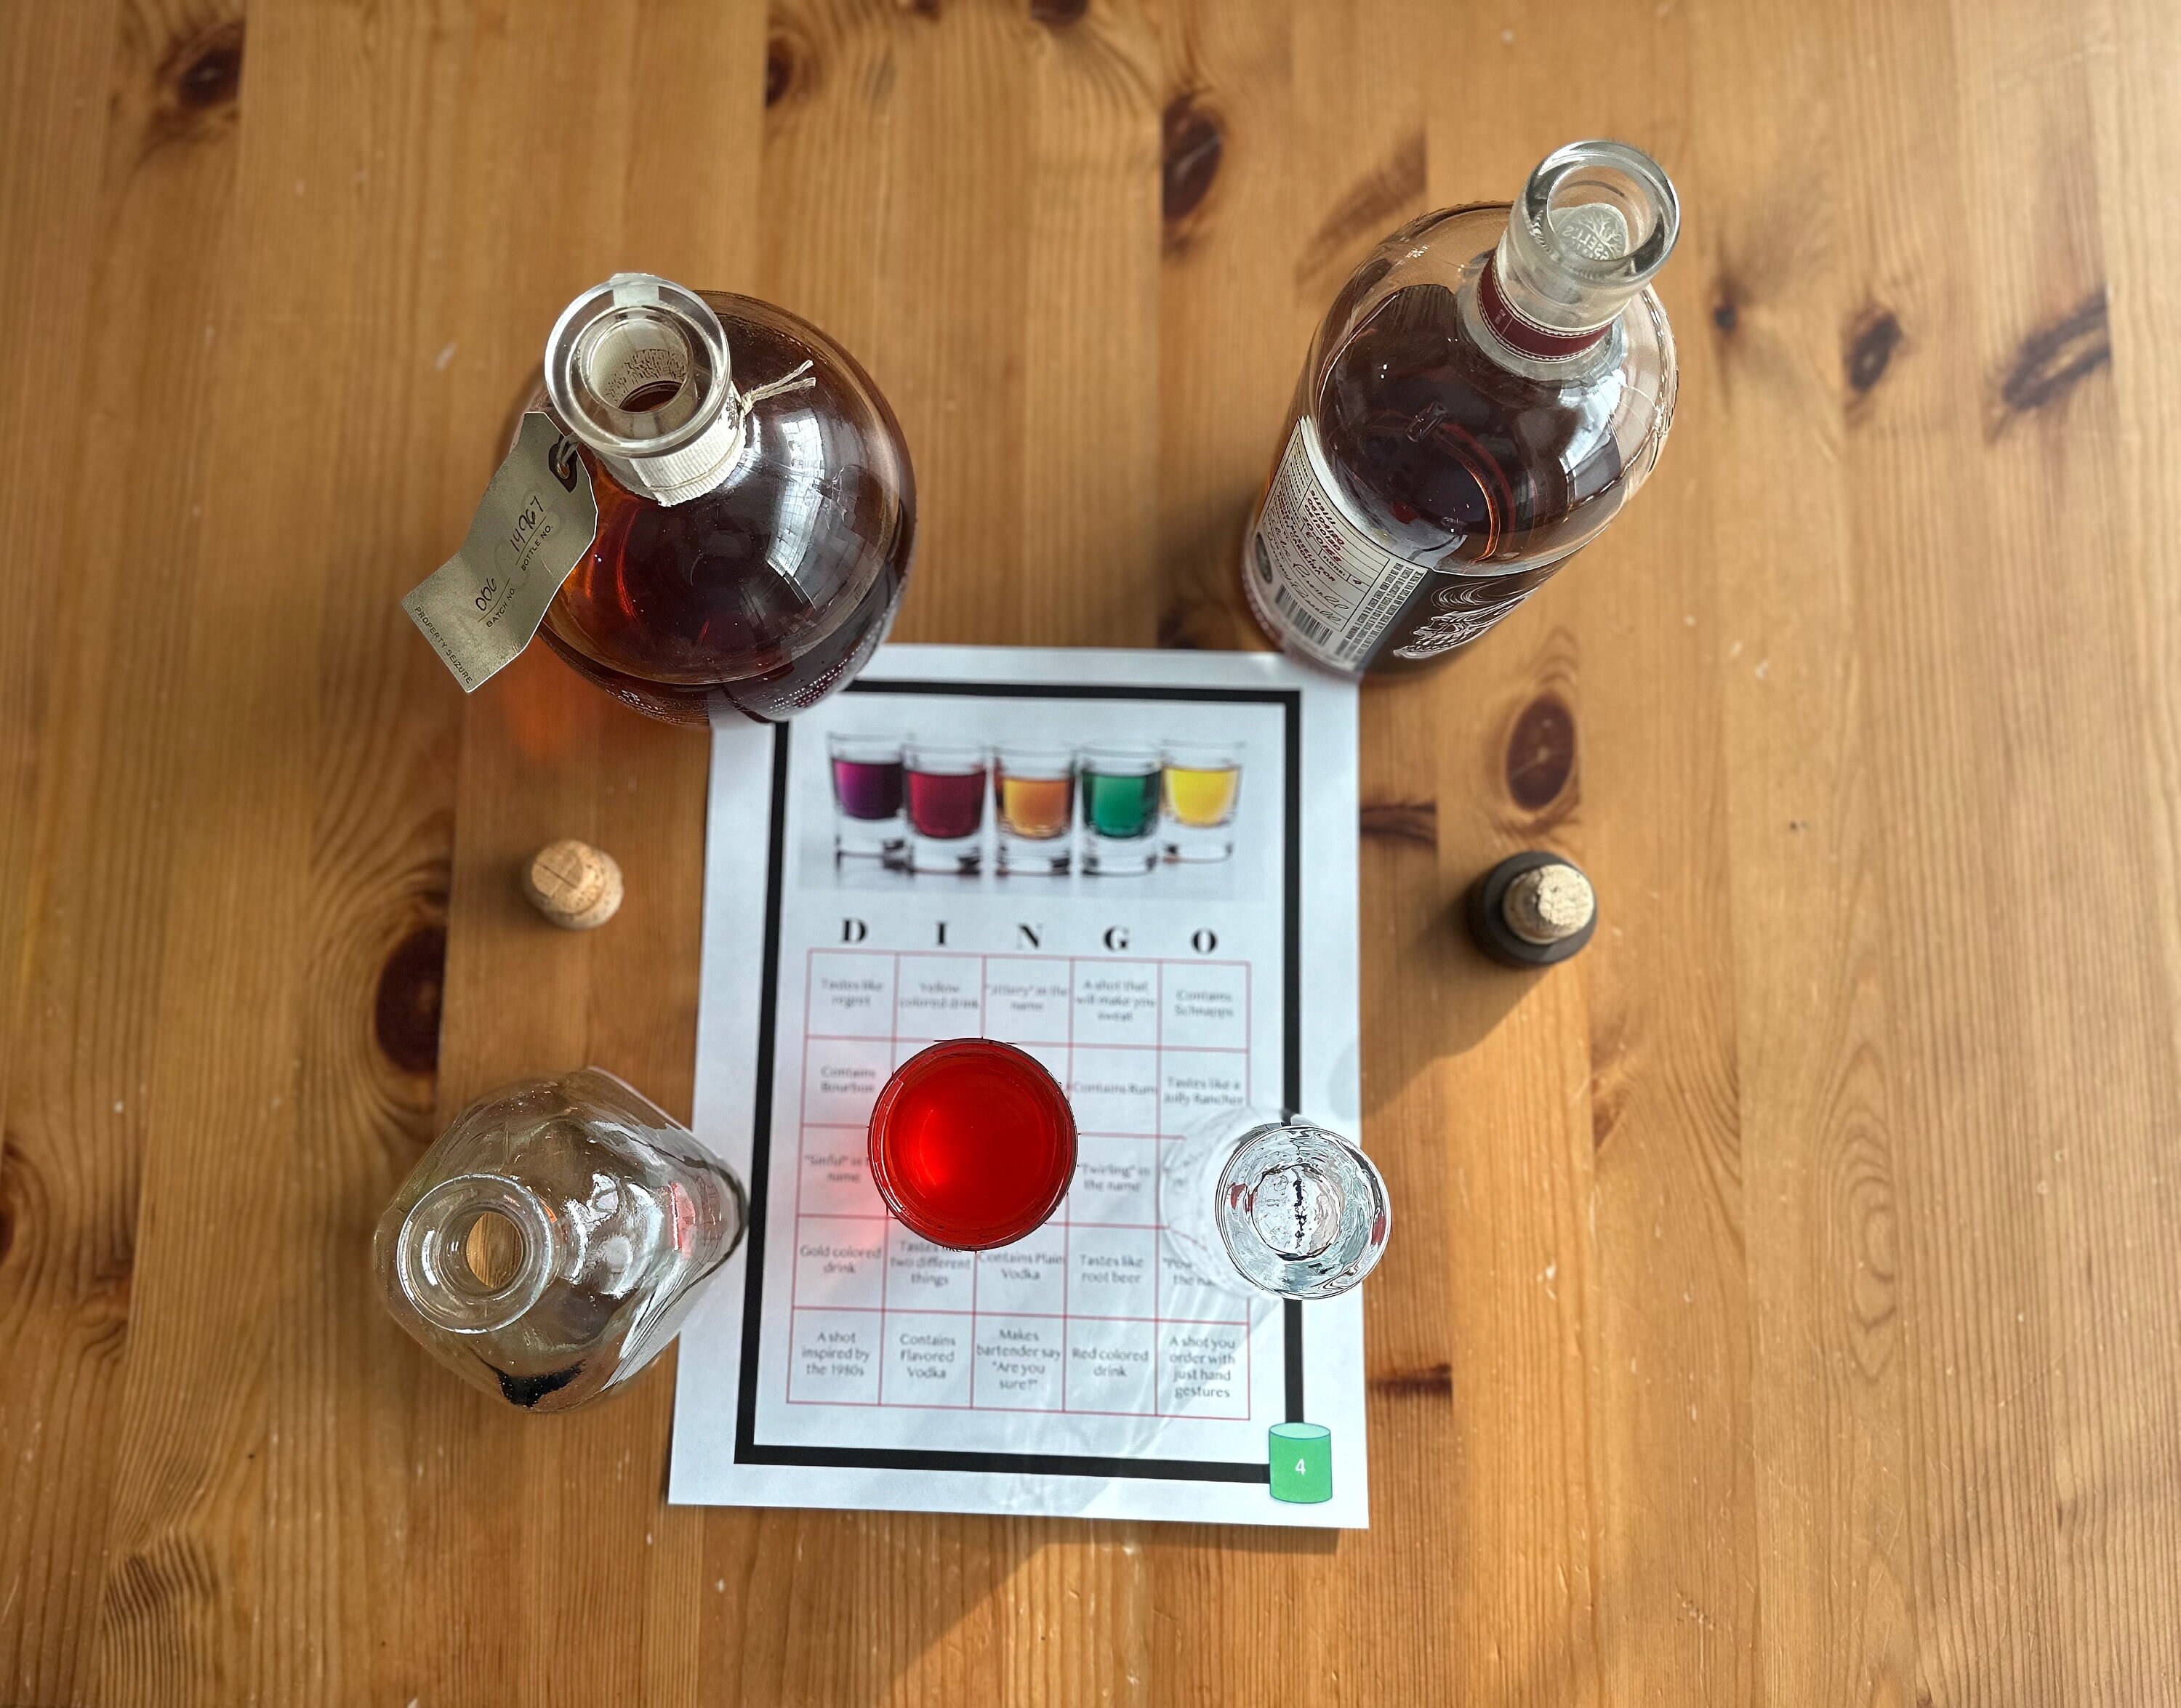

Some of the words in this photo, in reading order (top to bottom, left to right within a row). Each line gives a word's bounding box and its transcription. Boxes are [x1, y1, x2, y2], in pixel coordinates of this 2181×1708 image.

[510, 495, 545, 552] 14967
[521, 539, 542, 572] BOTTLE
[540, 524, 555, 538] NO.
[486, 602, 508, 629] BATCH
[414, 606, 448, 650] PROPERTY
[446, 648, 473, 685] SEIZURE
[842, 918, 869, 943] D
[937, 922, 948, 946] I
[1017, 922, 1043, 949] N
[1102, 926, 1129, 951] G
[1191, 927, 1218, 954] O
[1083, 980, 1093, 990] A
[1122, 980, 1149, 992] that
[1176, 988, 1233, 1002] Contains
[1076, 995, 1096, 1006] will
[1098, 995, 1130, 1007] make
[1133, 999, 1157, 1011] you
[1174, 1004, 1234, 1019] Schnapps
[820, 1066, 877, 1078] Contains
[1208, 1077, 1230, 1089] like
[1083, 1179, 1104, 1191] the
[1106, 1181, 1142, 1192] name
[800, 1244, 830, 1257] Gold
[832, 1246, 883, 1259] colored
[978, 1251, 1032, 1264] Contains
[822, 1262, 856, 1274] drink
[890, 1257, 914, 1268] two
[915, 1256, 973, 1269] different
[1079, 1254, 1119, 1268] Tastes
[1120, 1254, 1144, 1268] like
[910, 1273, 949, 1287] things
[1000, 1268, 1041, 1281] Vodka
[1081, 1272, 1110, 1284] root
[1112, 1272, 1141, 1284] beer
[817, 1332, 827, 1343] A
[828, 1330, 856, 1343] shot
[899, 1333, 957, 1346] Contains
[999, 1328, 1040, 1341] Makes
[1169, 1336, 1178, 1347] A
[1181, 1335, 1209, 1348] shot
[1210, 1339, 1236, 1351] you
[801, 1348, 853, 1361] inspired
[854, 1348, 871, 1363] by
[899, 1350, 955, 1363] Flavored
[976, 1345, 1040, 1358] bartender
[1042, 1347, 1061, 1361] say
[1072, 1347, 1097, 1360] Red
[1098, 1348, 1149, 1362] colored
[1169, 1352, 1206, 1364] order
[1208, 1353, 1236, 1365] with
[806, 1363, 827, 1375] the
[831, 1363, 864, 1377] 1980s
[907, 1366, 947, 1379] Vodka
[1020, 1363, 1046, 1377] you
[1093, 1364, 1127, 1377] drink
[1173, 1366, 1197, 1382] just
[1200, 1369, 1232, 1382] hand
[1174, 1385, 1230, 1400] gestures
[1295, 1458, 1306, 1476] 4
